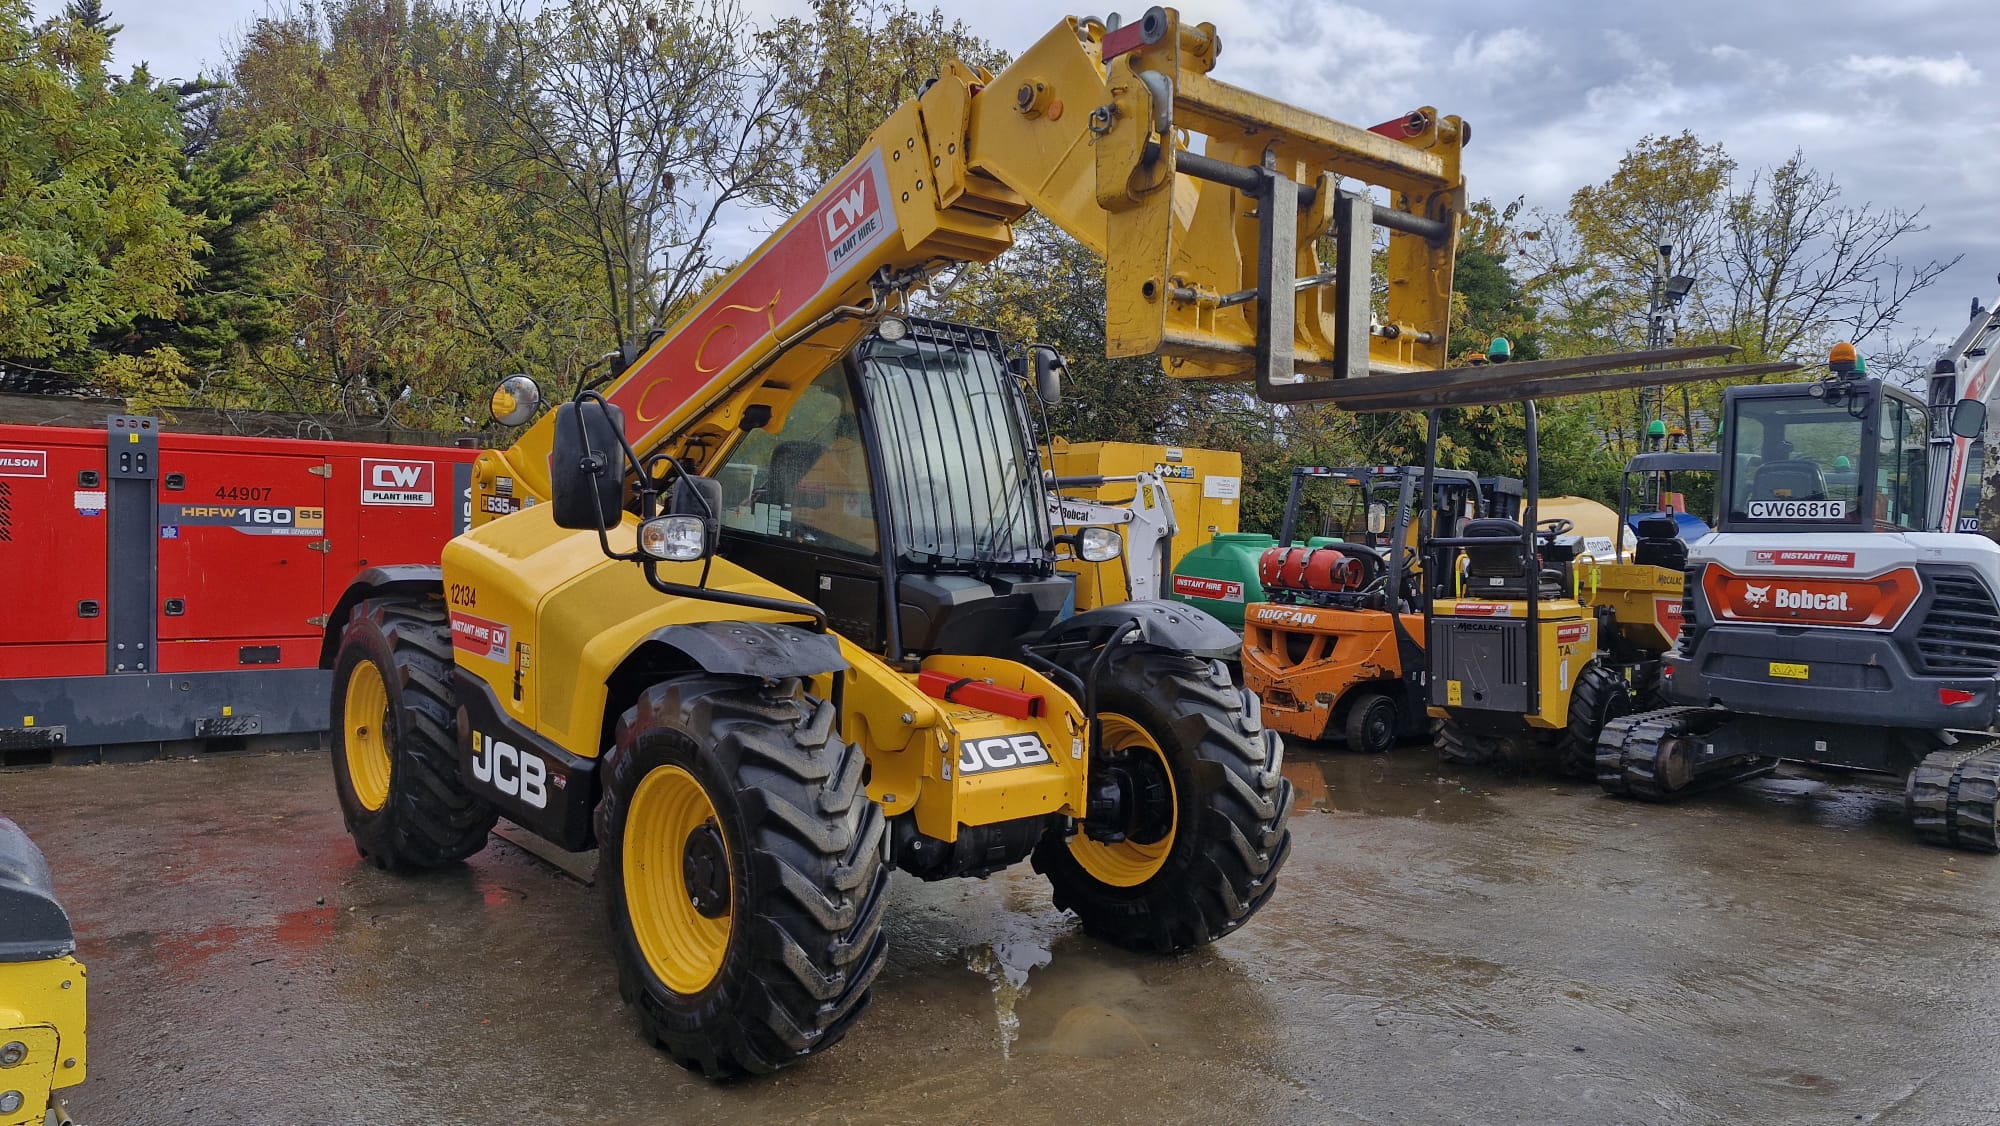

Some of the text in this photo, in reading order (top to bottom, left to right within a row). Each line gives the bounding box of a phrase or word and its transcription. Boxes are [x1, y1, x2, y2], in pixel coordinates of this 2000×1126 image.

[826, 180, 865, 242] CW
[833, 217, 877, 262] PLANT HIRE
[372, 464, 422, 489] CW
[215, 486, 273, 501] 44907
[372, 492, 424, 501] PLANT HIRE
[181, 507, 323, 525] HRFW 160 S5
[1062, 507, 1089, 522] Bobcat
[1749, 502, 1841, 517] CW66816
[1781, 552, 1821, 560] INSTANT
[1176, 578, 1204, 589] INSTANT
[1206, 583, 1222, 591] HIRE
[450, 583, 476, 608] 12134
[1775, 588, 1848, 611] Bobcat
[452, 619, 489, 639] INSTANT HIRE
[493, 630, 505, 645] CW
[959, 735, 1049, 772] JCB
[473, 735, 547, 809] JCB
